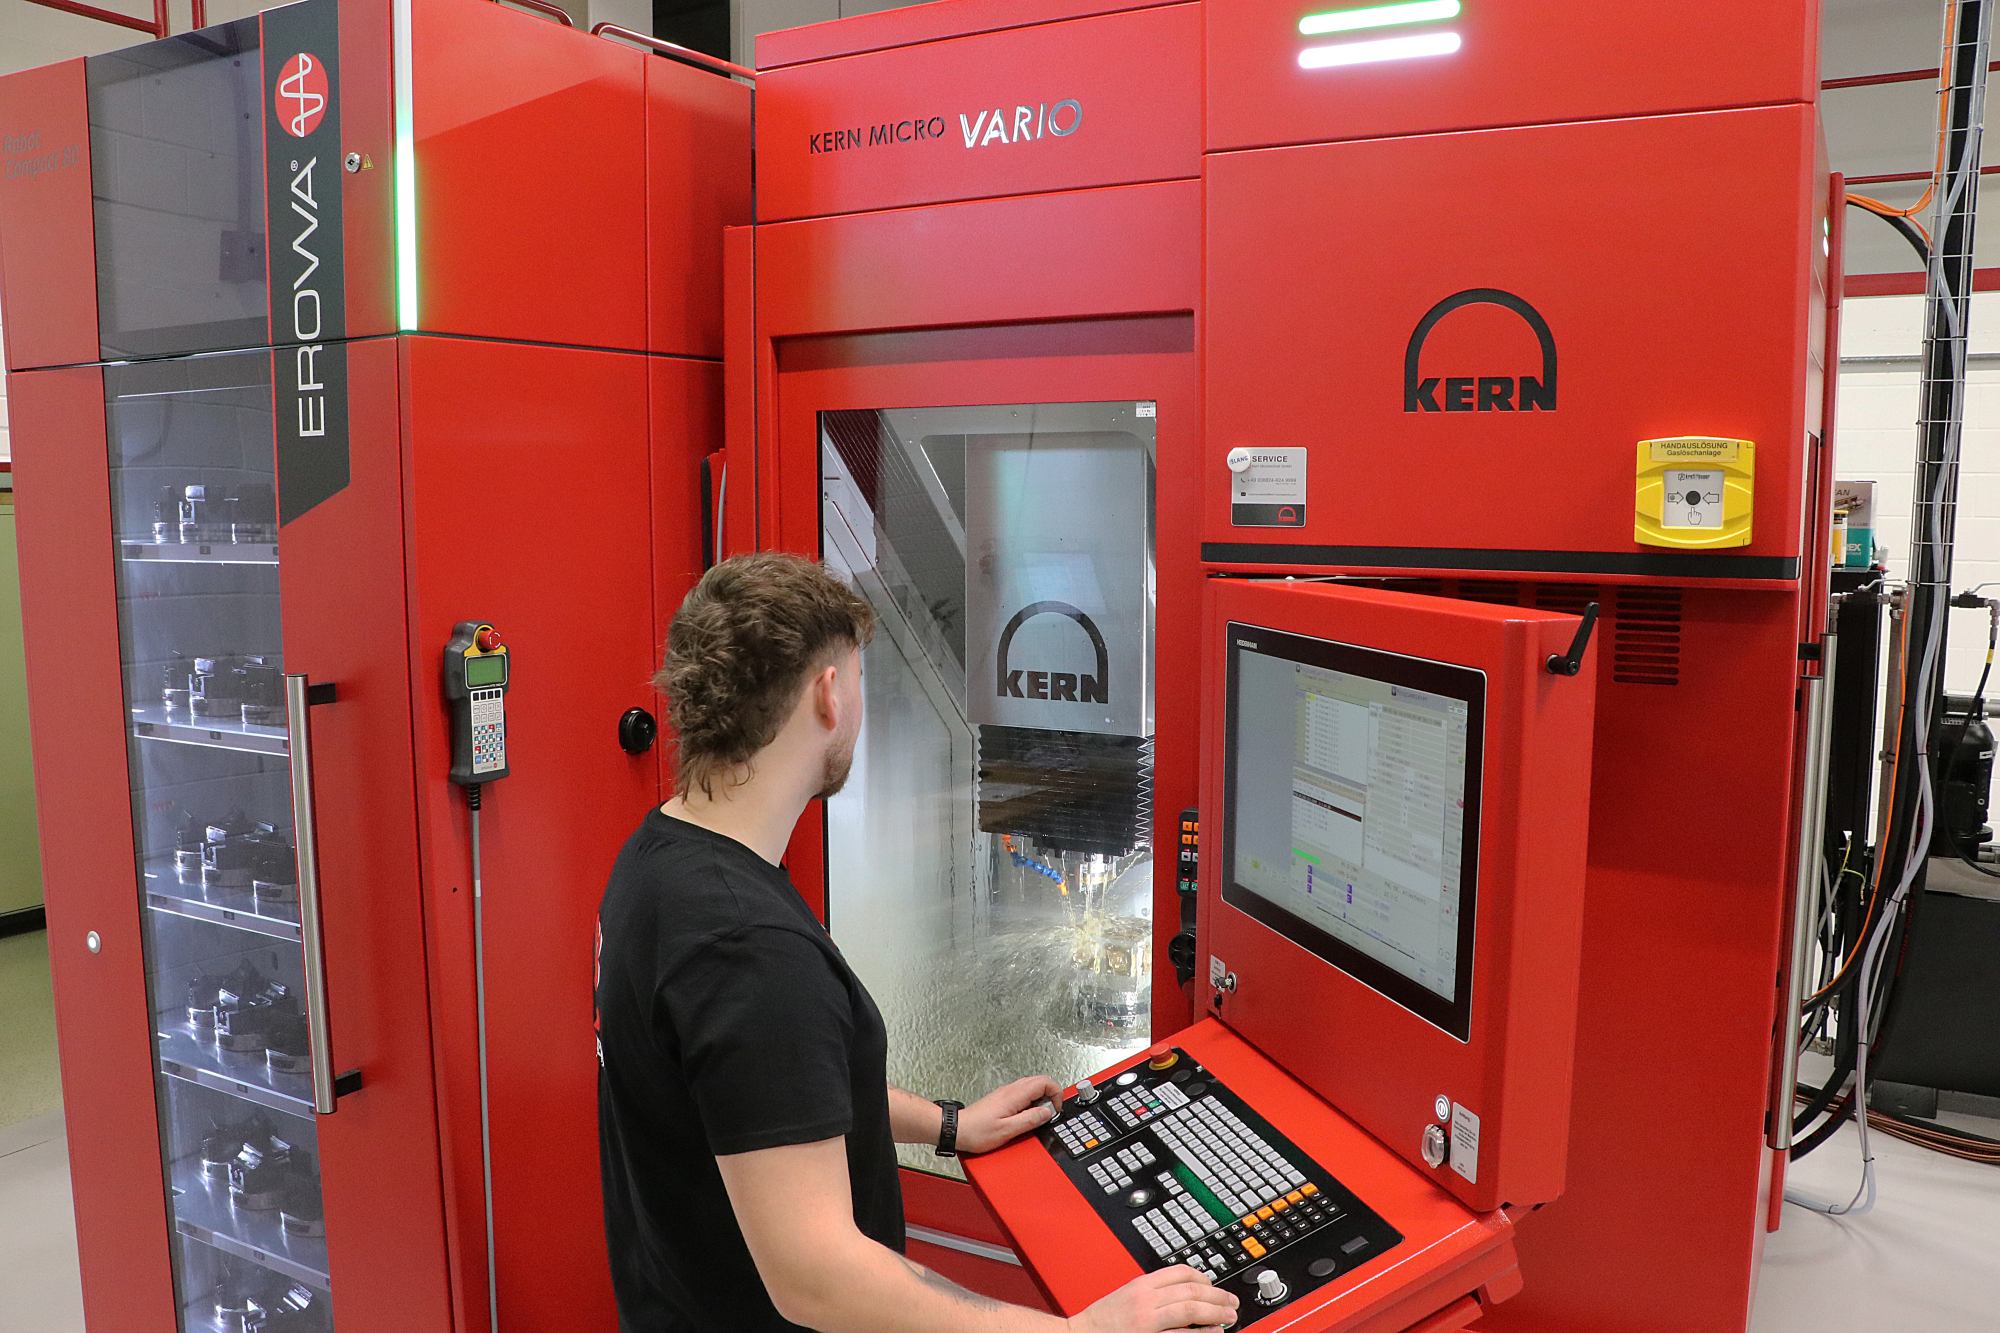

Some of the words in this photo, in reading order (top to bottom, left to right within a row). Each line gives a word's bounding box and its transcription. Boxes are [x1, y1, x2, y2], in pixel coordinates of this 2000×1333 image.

[809, 128, 862, 154] KERN
[869, 116, 945, 146] MICRO
[959, 99, 1082, 149] VARIO
[1404, 376, 1556, 412] KERN
[1252, 455, 1288, 463] SERVICE
[1666, 449, 1722, 457] Gaslöschanlage
[997, 669, 1108, 704] KERN
